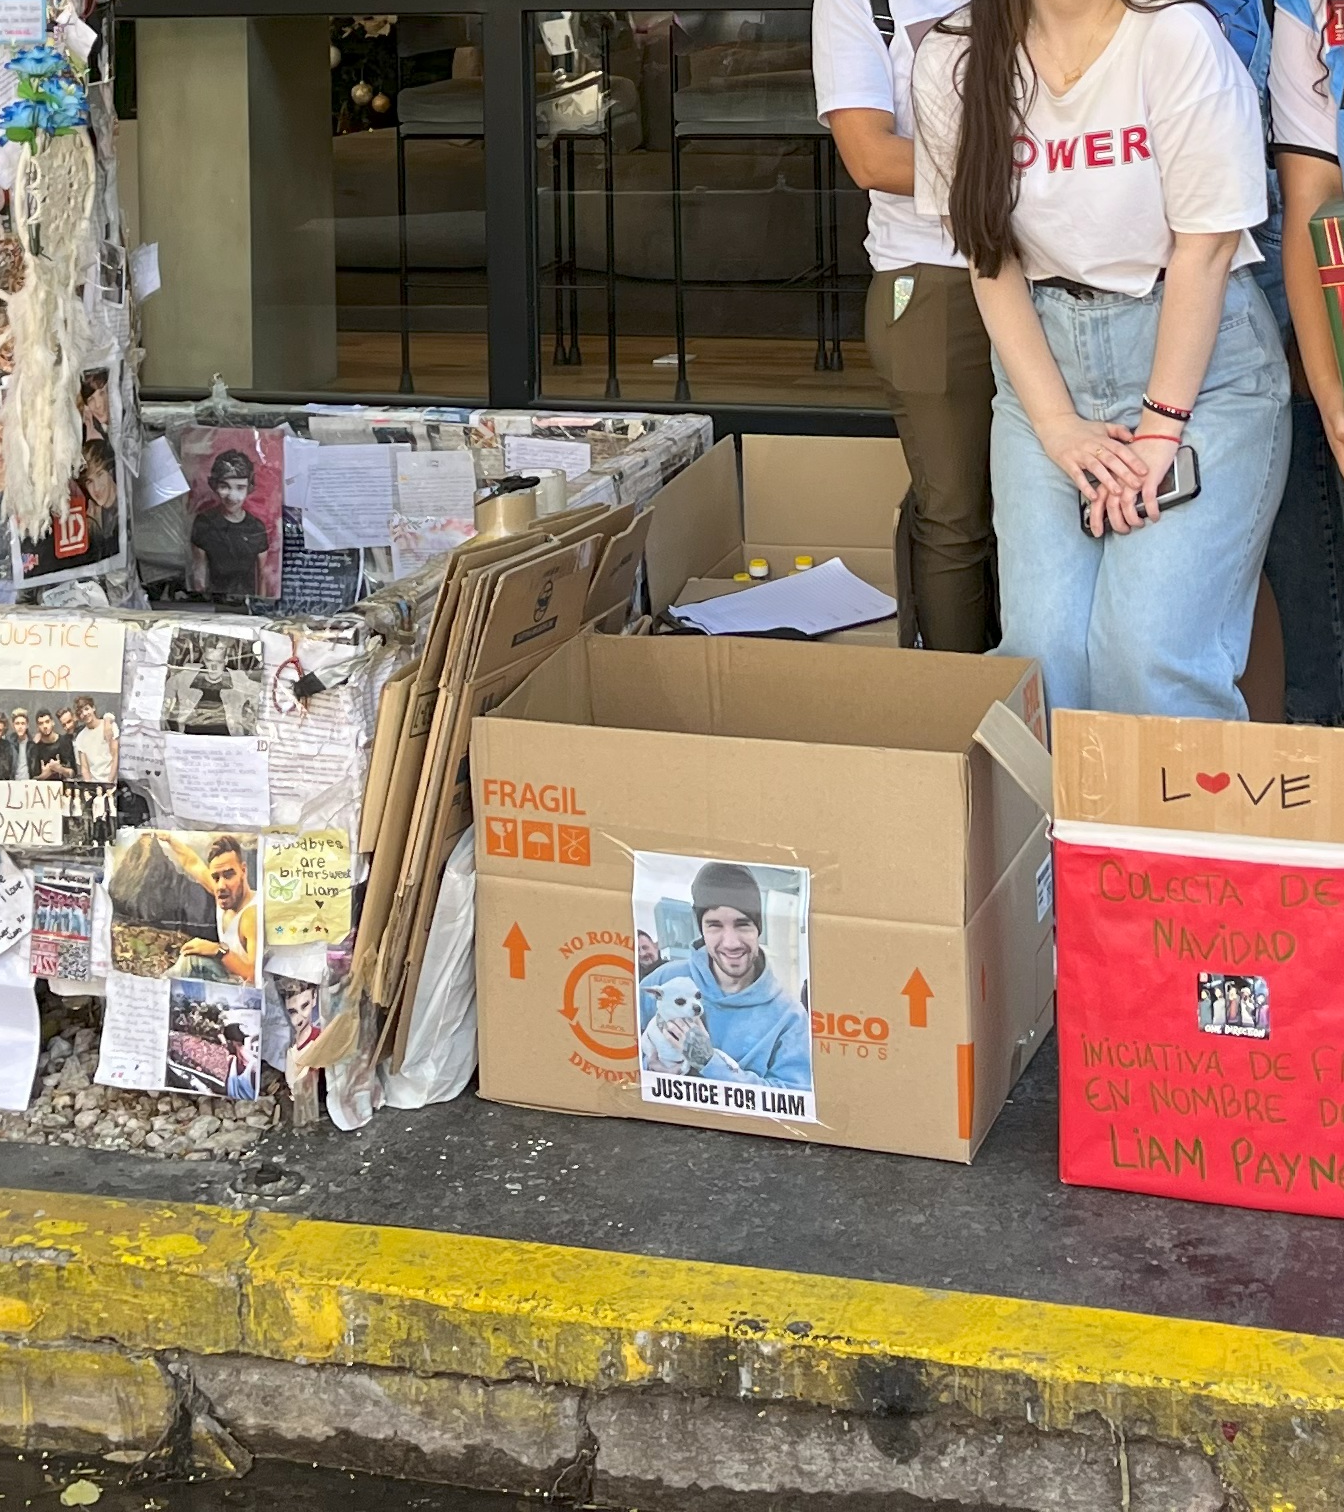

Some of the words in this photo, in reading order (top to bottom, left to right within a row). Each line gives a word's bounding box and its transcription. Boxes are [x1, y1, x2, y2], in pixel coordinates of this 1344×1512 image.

[28, 664, 71, 690] FOR
[483, 778, 587, 816] FRAGIL
[300, 857, 326, 868] are
[305, 883, 339, 898] Liam
[1100, 860, 1244, 906] COLECTA
[1281, 874, 1340, 908] DE
[558, 936, 585, 960] NO
[1250, 1051, 1291, 1081] DE
[652, 1077, 719, 1105] JUSTICE
[724, 1085, 756, 1111] FOR
[762, 1091, 806, 1117] LIAM
[1086, 1077, 1131, 1114] EN
[1150, 1082, 1287, 1123] NOMBRE
